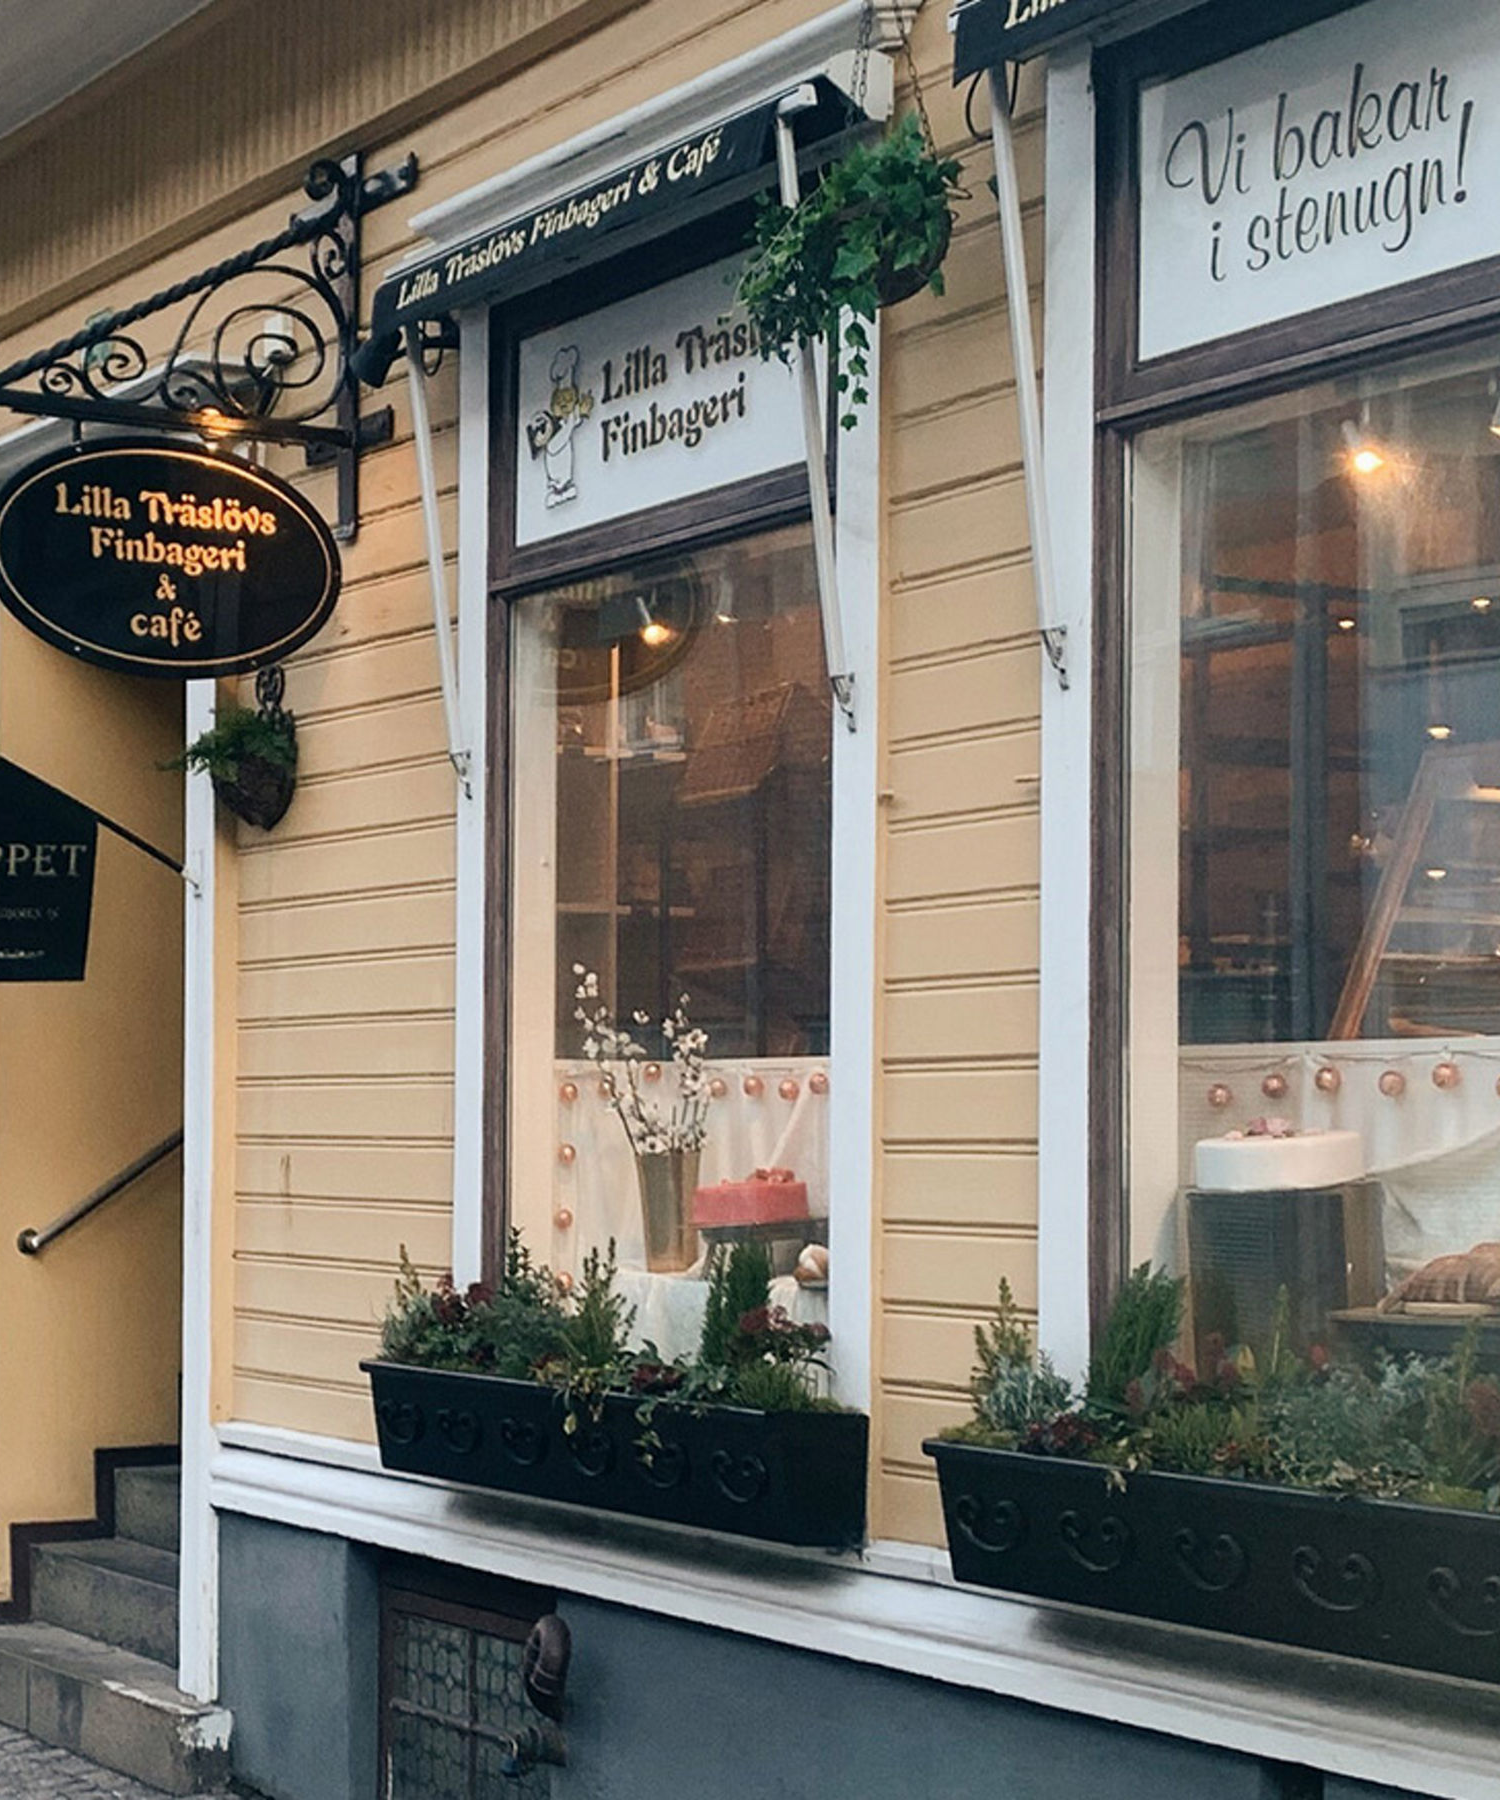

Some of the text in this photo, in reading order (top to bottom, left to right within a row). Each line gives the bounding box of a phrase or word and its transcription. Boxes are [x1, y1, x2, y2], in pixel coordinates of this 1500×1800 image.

[1164, 62, 1450, 205] Vi bakar
[396, 126, 725, 310] Lilla Träslövs Finbageri & Café
[1210, 101, 1474, 282] i stenugn!
[601, 315, 760, 405] Lilla Träsl
[601, 370, 747, 463] Finbageri
[55, 482, 278, 536] Lilla Träslövs
[89, 525, 248, 577] Finbageri
[129, 605, 203, 648] café
[156, 573, 177, 601] &
